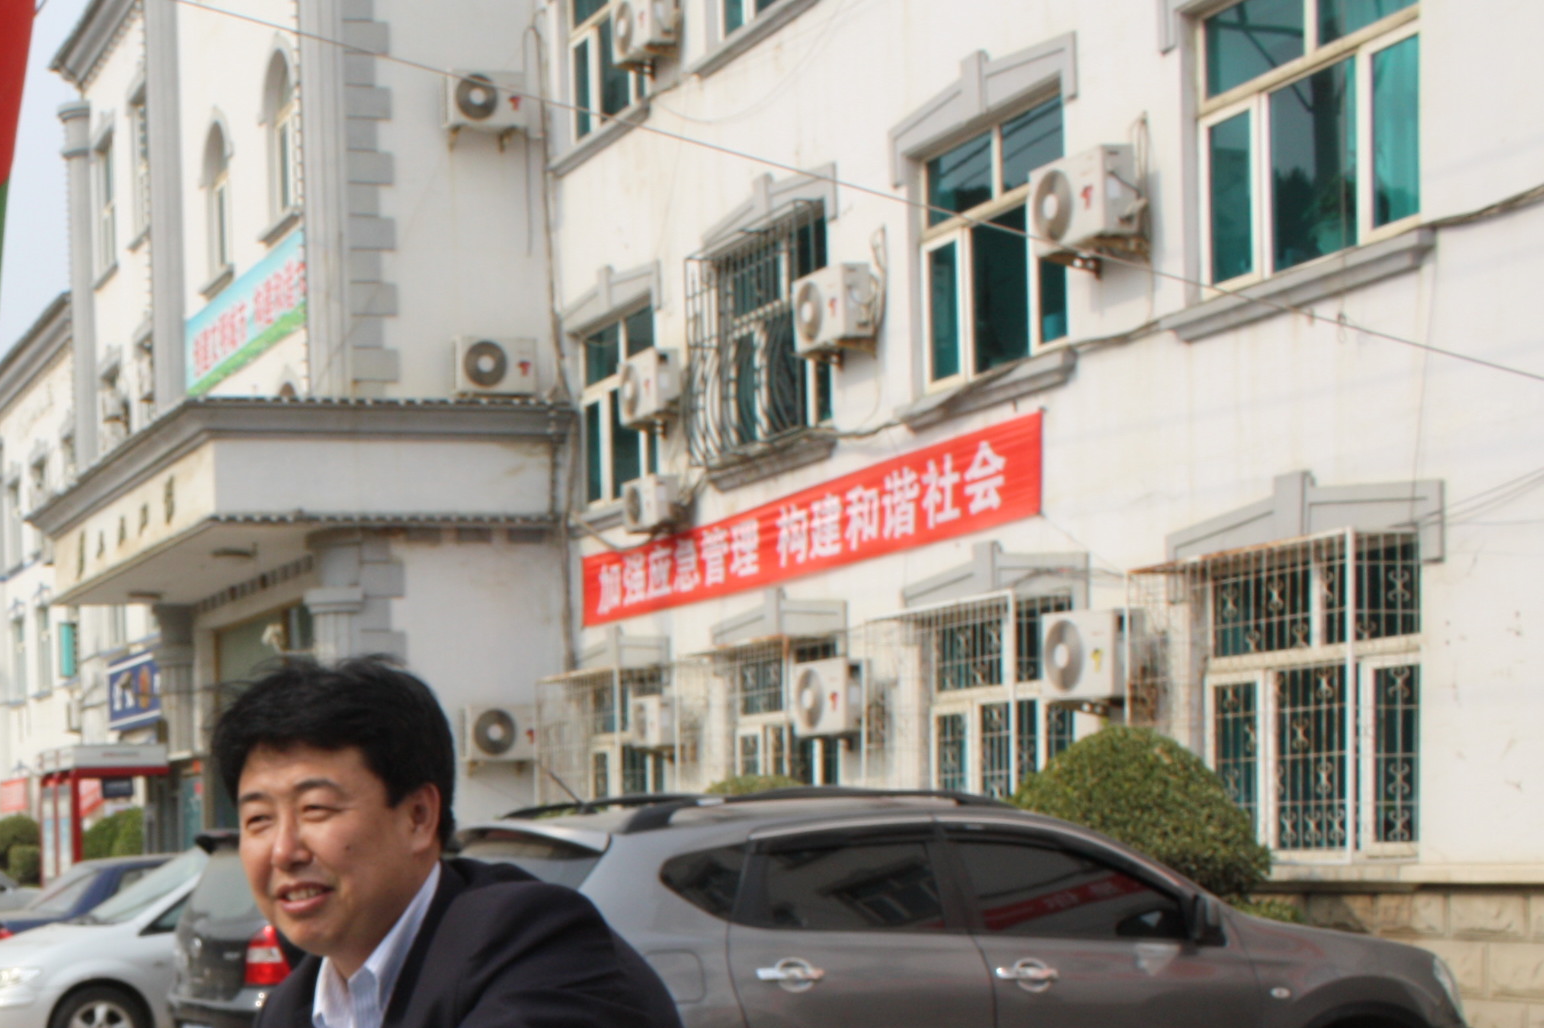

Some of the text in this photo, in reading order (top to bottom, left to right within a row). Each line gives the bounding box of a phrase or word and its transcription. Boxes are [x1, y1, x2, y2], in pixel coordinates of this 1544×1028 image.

[597, 441, 1006, 615] 加强应急管理 构建和谐社会
